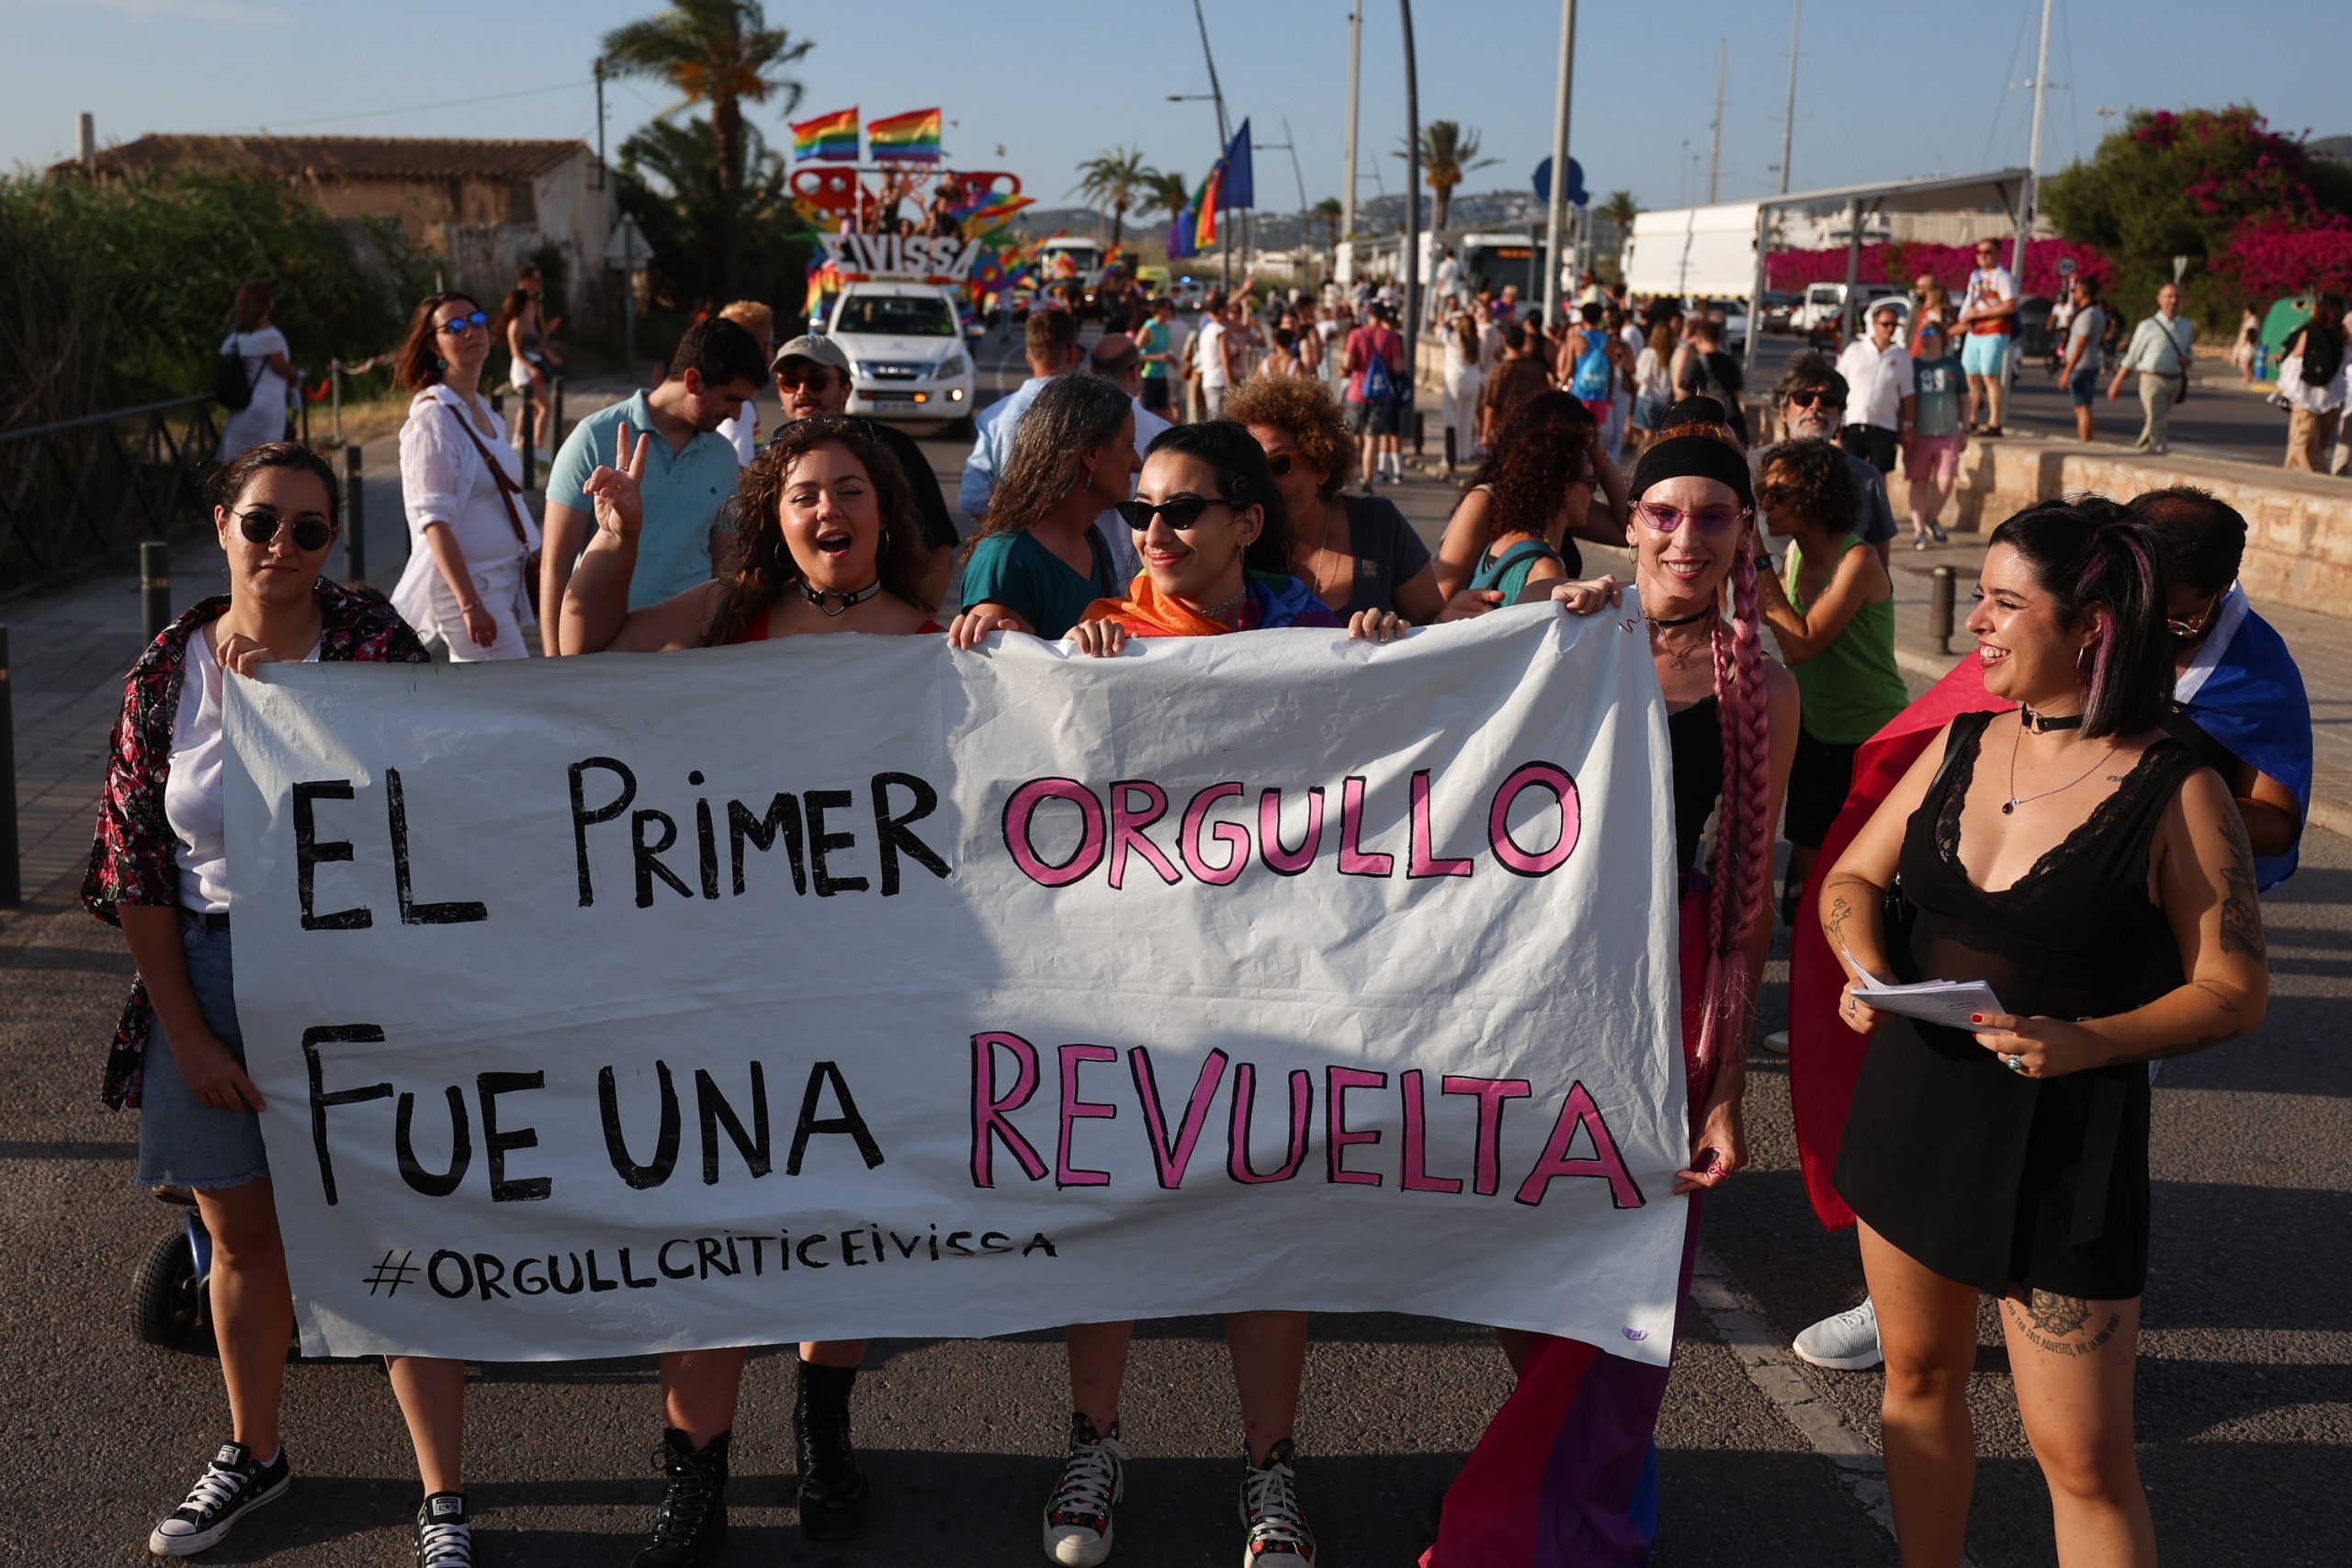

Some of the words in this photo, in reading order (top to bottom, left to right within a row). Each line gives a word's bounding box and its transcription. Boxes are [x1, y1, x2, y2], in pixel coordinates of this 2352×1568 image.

[817, 232, 983, 280] EIVISSA
[292, 766, 488, 931] EL
[1001, 760, 1581, 891] ORGULLO
[301, 1023, 552, 1207] FUE
[597, 1059, 885, 1190] UNA
[969, 1031, 1647, 1210] REVUELTA
